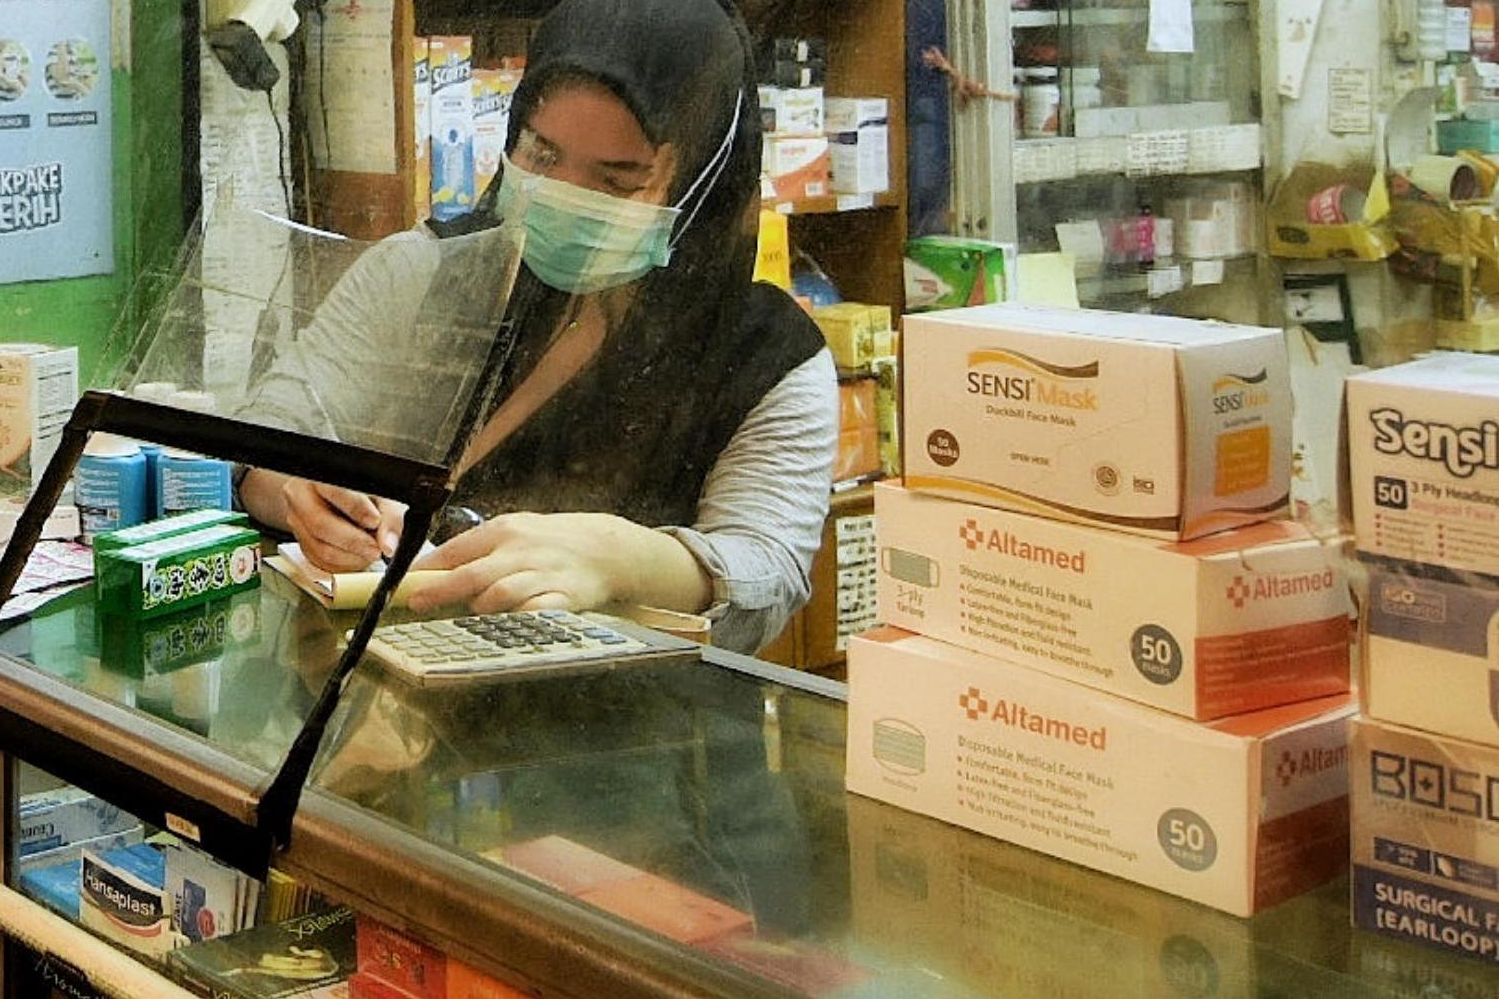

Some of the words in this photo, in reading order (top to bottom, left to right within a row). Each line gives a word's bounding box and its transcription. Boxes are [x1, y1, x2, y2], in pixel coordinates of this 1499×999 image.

[967, 371, 1032, 402] SENSI
[1037, 383, 1098, 411] Mask
[1212, 393, 1243, 415] SENSI
[985, 403, 1025, 420] Duckbill
[1027, 410, 1048, 423] Face
[1051, 413, 1077, 428] Mask
[1370, 407, 1499, 479] Sensi
[1377, 482, 1405, 505] 50
[1410, 481, 1420, 494] 3
[1422, 482, 1442, 500] Ply
[987, 528, 1086, 574] Altamed
[959, 563, 1007, 586] Disposable
[1009, 576, 1043, 597] Medical
[1045, 586, 1066, 602] Face
[1068, 593, 1093, 611] Mask
[1251, 565, 1334, 602] Altamed
[1141, 633, 1172, 665] 50
[991, 699, 1108, 752] Altamed
[958, 734, 1014, 762] Disposable
[1016, 750, 1056, 775] Medical
[1058, 764, 1083, 781] Face
[1086, 772, 1115, 791] Mask
[1169, 818, 1204, 852] 50
[84, 868, 157, 918] Hansaplast
[1375, 882, 1480, 928] SURGICAL
